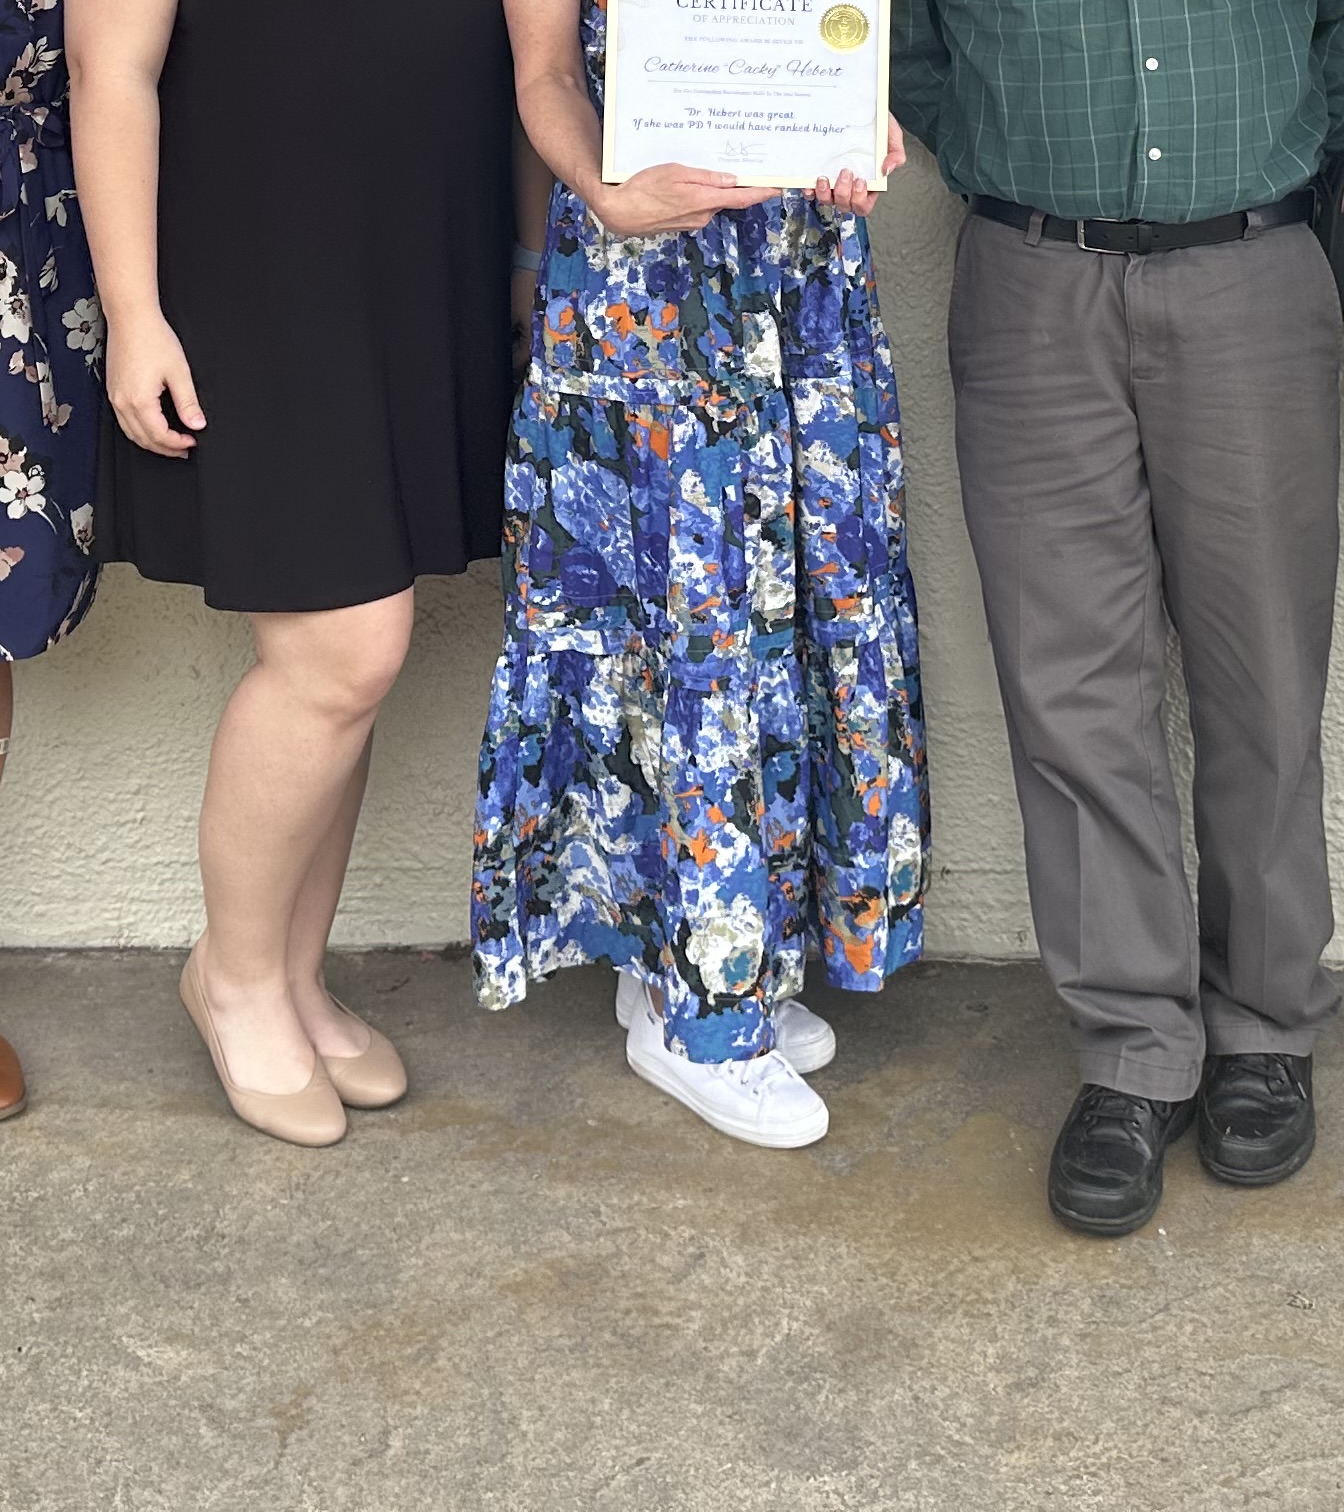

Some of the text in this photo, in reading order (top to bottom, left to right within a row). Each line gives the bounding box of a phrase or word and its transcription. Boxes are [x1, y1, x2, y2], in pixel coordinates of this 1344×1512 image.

[692, 14, 795, 26] OF APPRECIATION
[644, 56, 721, 73] Catherine
[786, 59, 844, 77] Hebert
[708, 108, 741, 117] Hebert
[633, 118, 644, 131] If
[644, 118, 662, 128] she
[664, 121, 684, 129] was
[687, 120, 704, 129] PD
[714, 121, 746, 131] would
[748, 121, 772, 132] have
[774, 123, 811, 133] ranked
